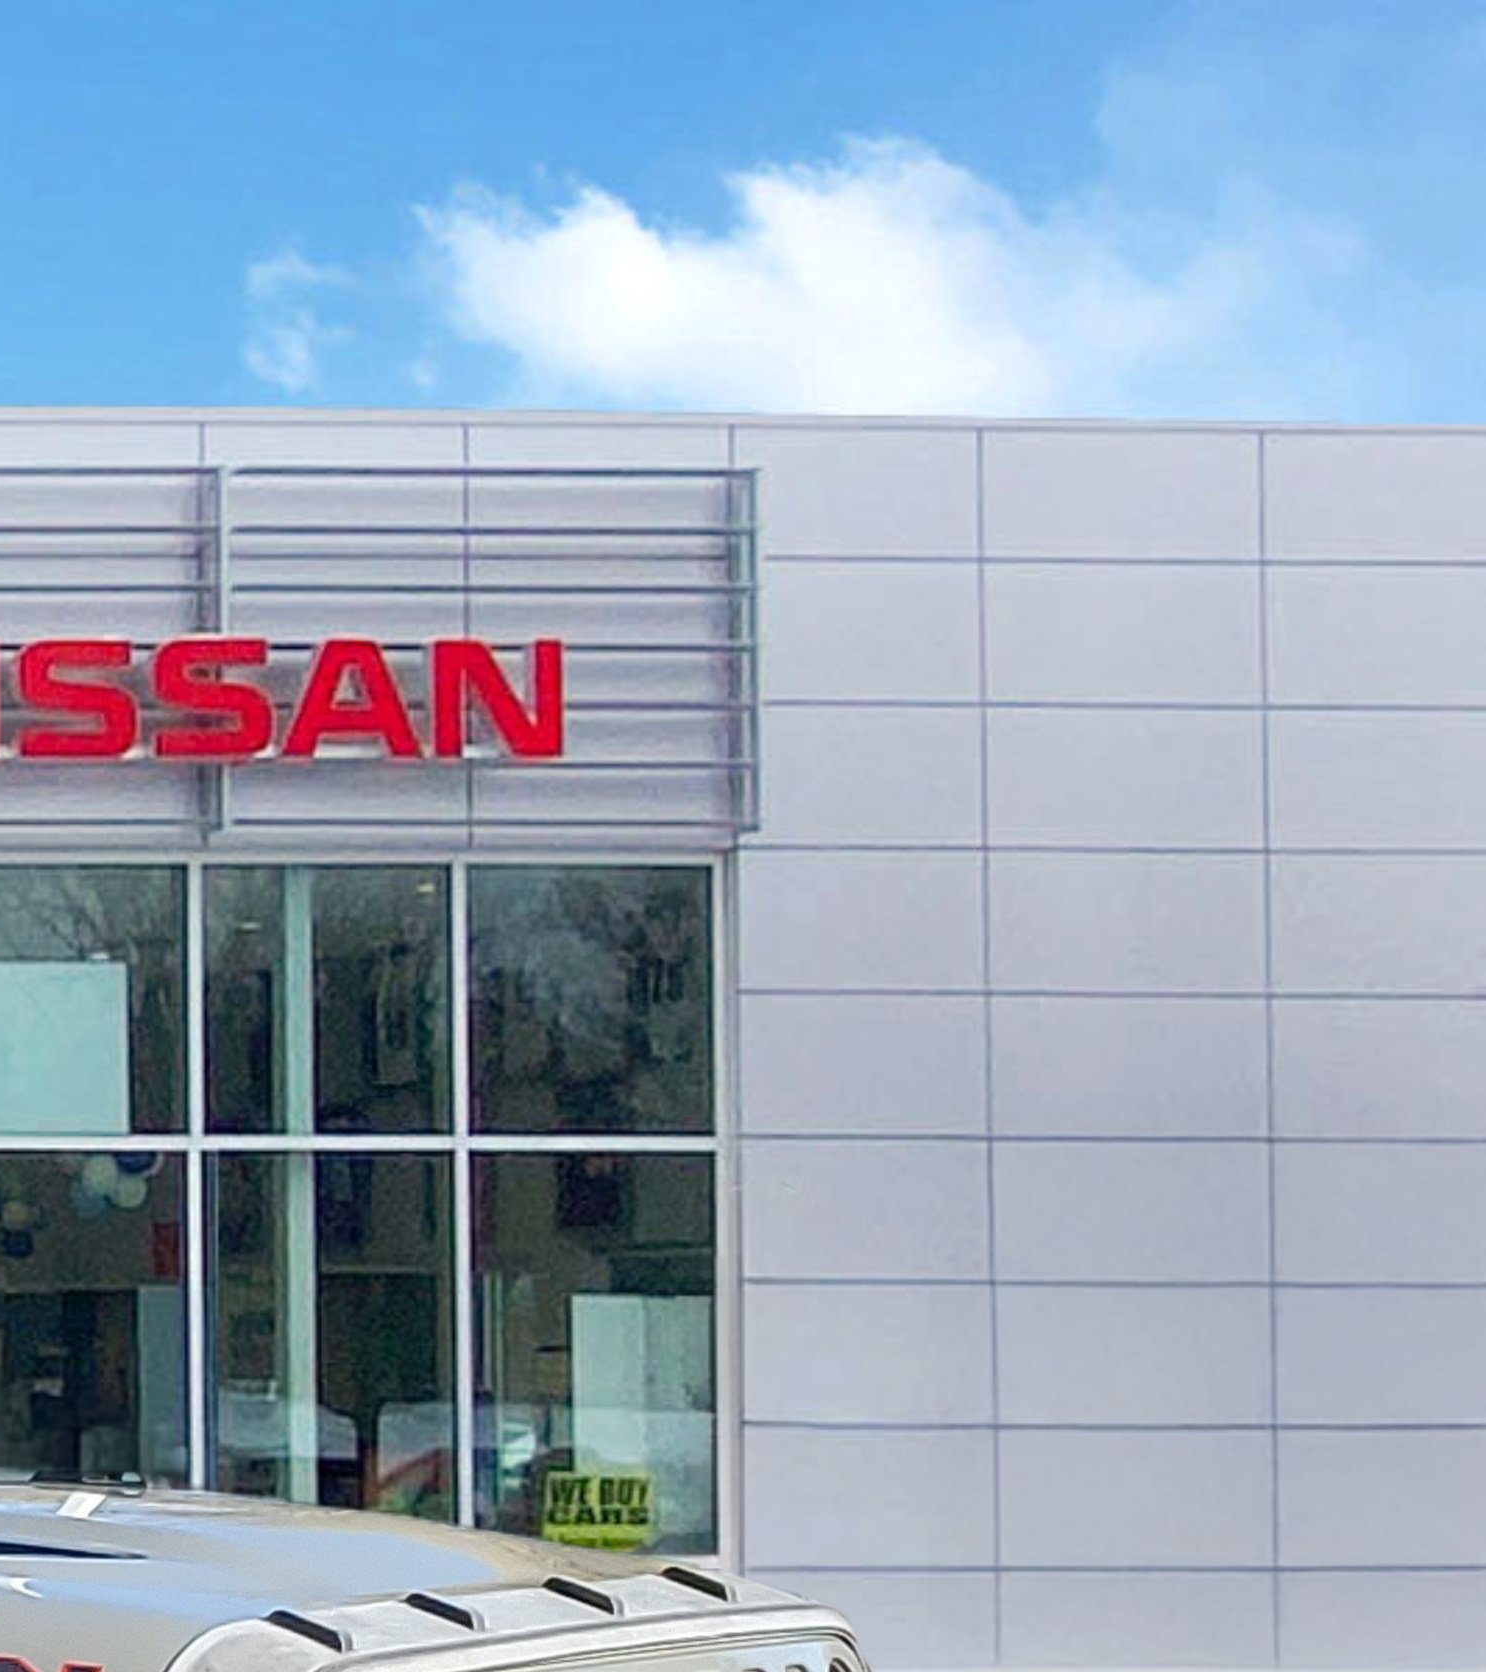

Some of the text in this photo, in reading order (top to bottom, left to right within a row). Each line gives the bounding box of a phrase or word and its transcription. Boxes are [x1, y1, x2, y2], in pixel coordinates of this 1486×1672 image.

[550, 1475, 650, 1505] WE BUY
[547, 1506, 650, 1525] CARS
